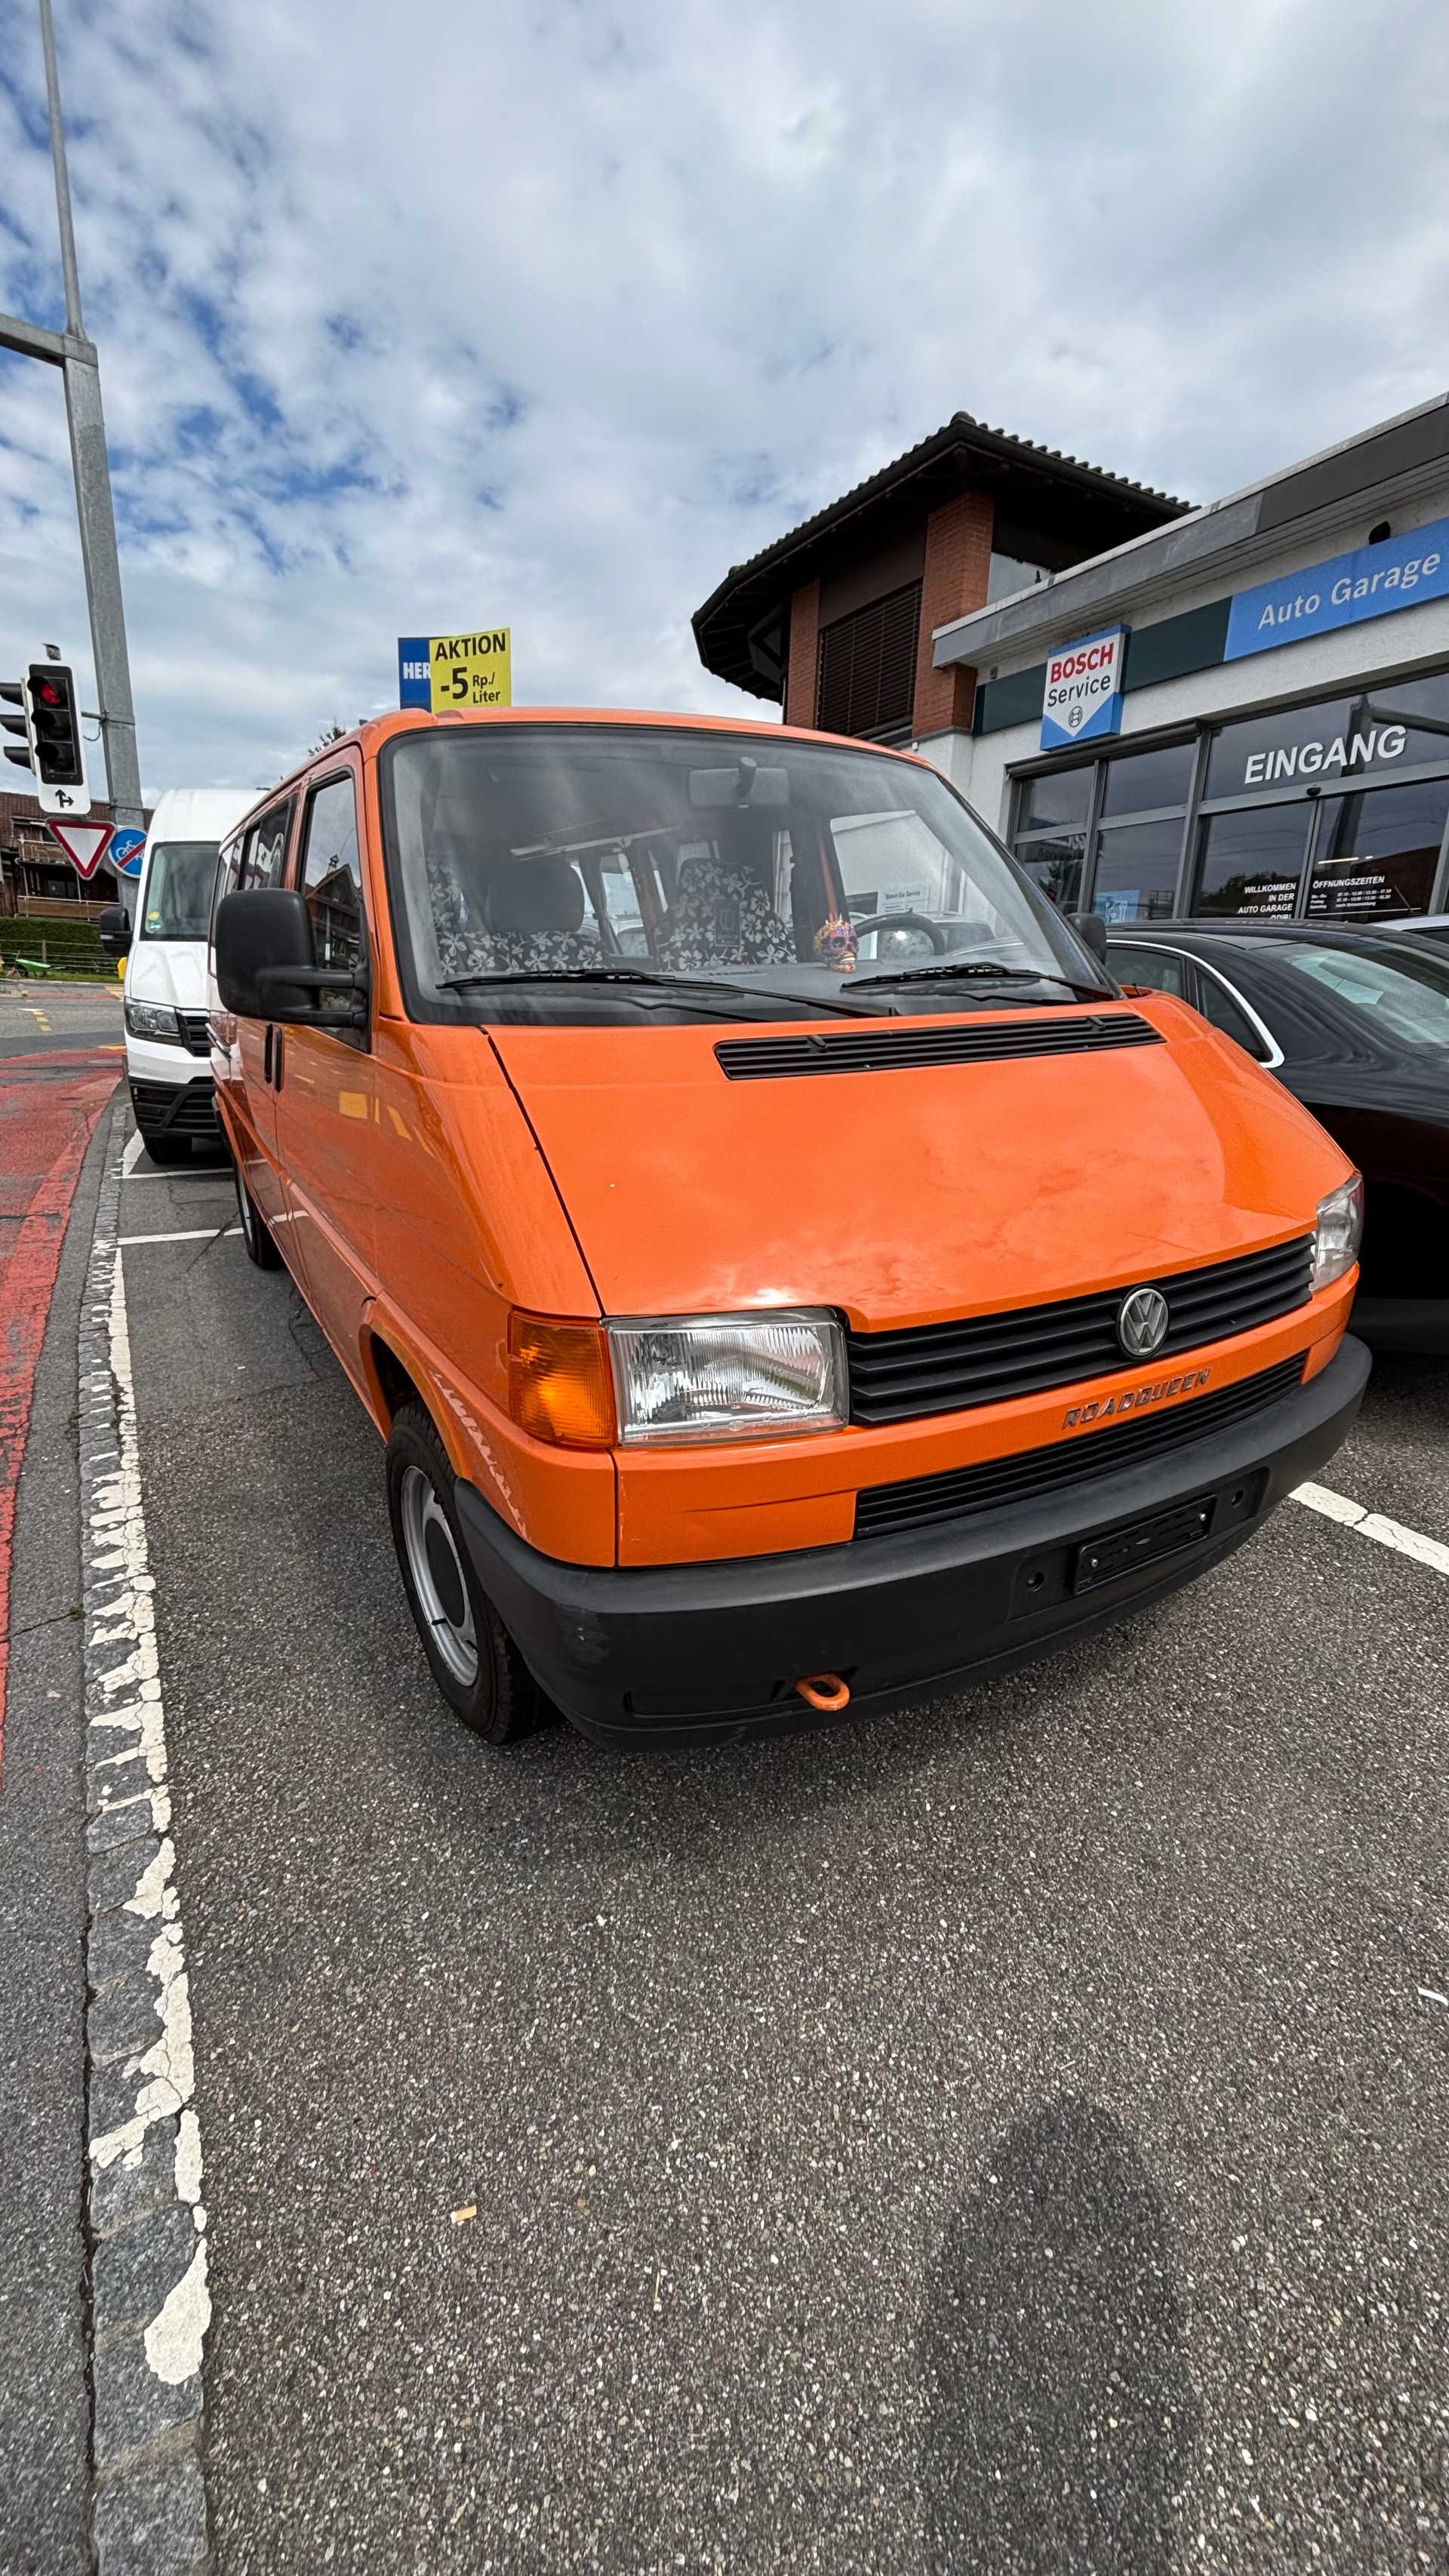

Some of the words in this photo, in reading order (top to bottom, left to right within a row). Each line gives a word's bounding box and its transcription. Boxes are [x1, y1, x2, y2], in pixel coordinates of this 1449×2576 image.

[1257, 593, 1321, 630] Auto
[1331, 552, 1441, 605] Garage
[435, 632, 506, 661] AKTION
[1050, 642, 1115, 685] BOSCH
[440, 666, 469, 700] -5
[472, 690, 501, 704] Liter
[1048, 675, 1111, 707] Service
[1244, 725, 1407, 784] EINGANG
[1244, 882, 1297, 894] WILLKOMMEN
[1278, 893, 1295, 902] DER
[1312, 876, 1386, 889] ÖFFNUNGSZEITEN
[1238, 906, 1259, 914] AUTO
[1260, 903, 1294, 913] GARAGE
[1062, 1367, 1211, 1430] ROADQUEEN
